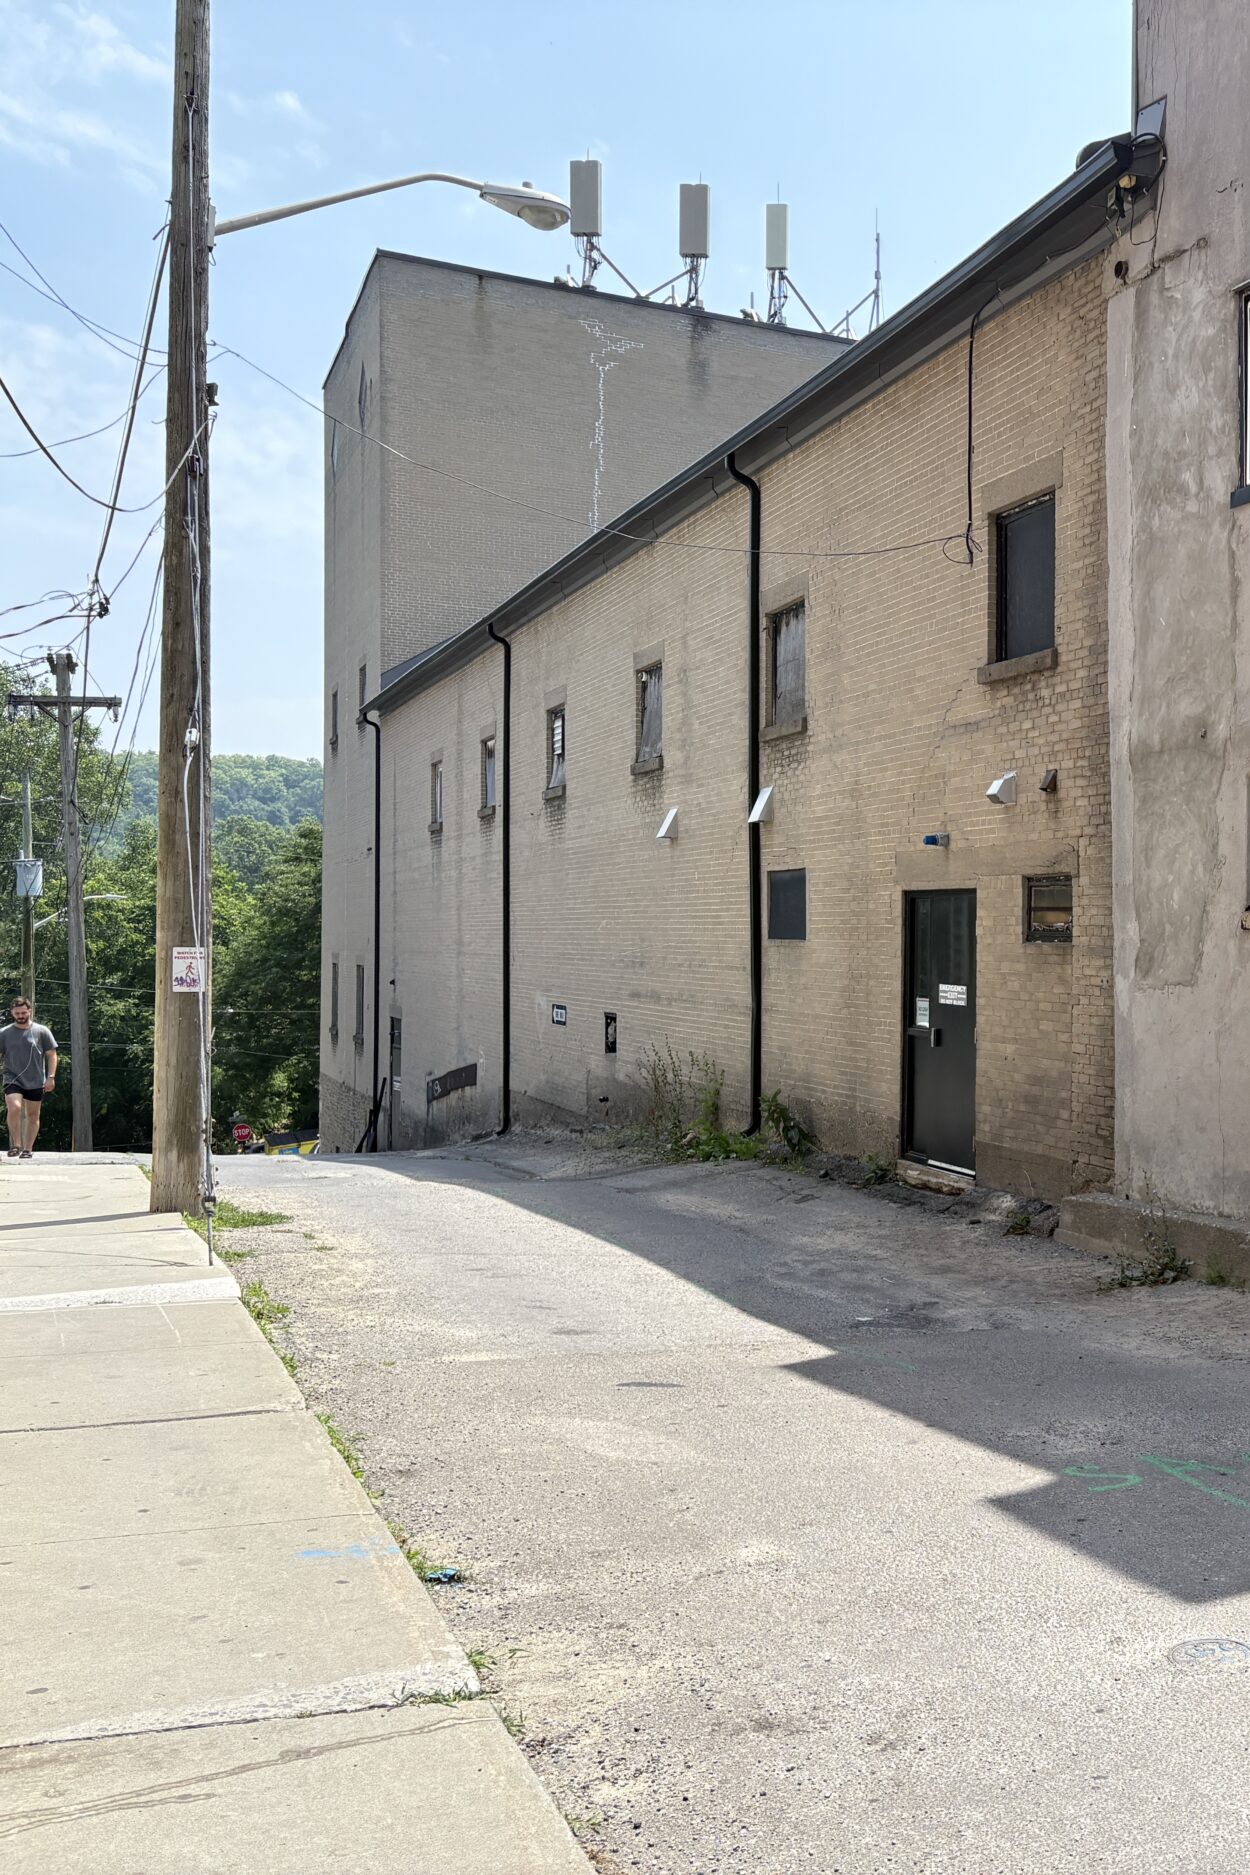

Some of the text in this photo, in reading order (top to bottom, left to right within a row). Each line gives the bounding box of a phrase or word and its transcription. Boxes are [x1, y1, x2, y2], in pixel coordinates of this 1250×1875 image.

[939, 984, 967, 992] EMERGENCY
[947, 991, 958, 999] EXIT
[234, 1128, 250, 1137] STOP
